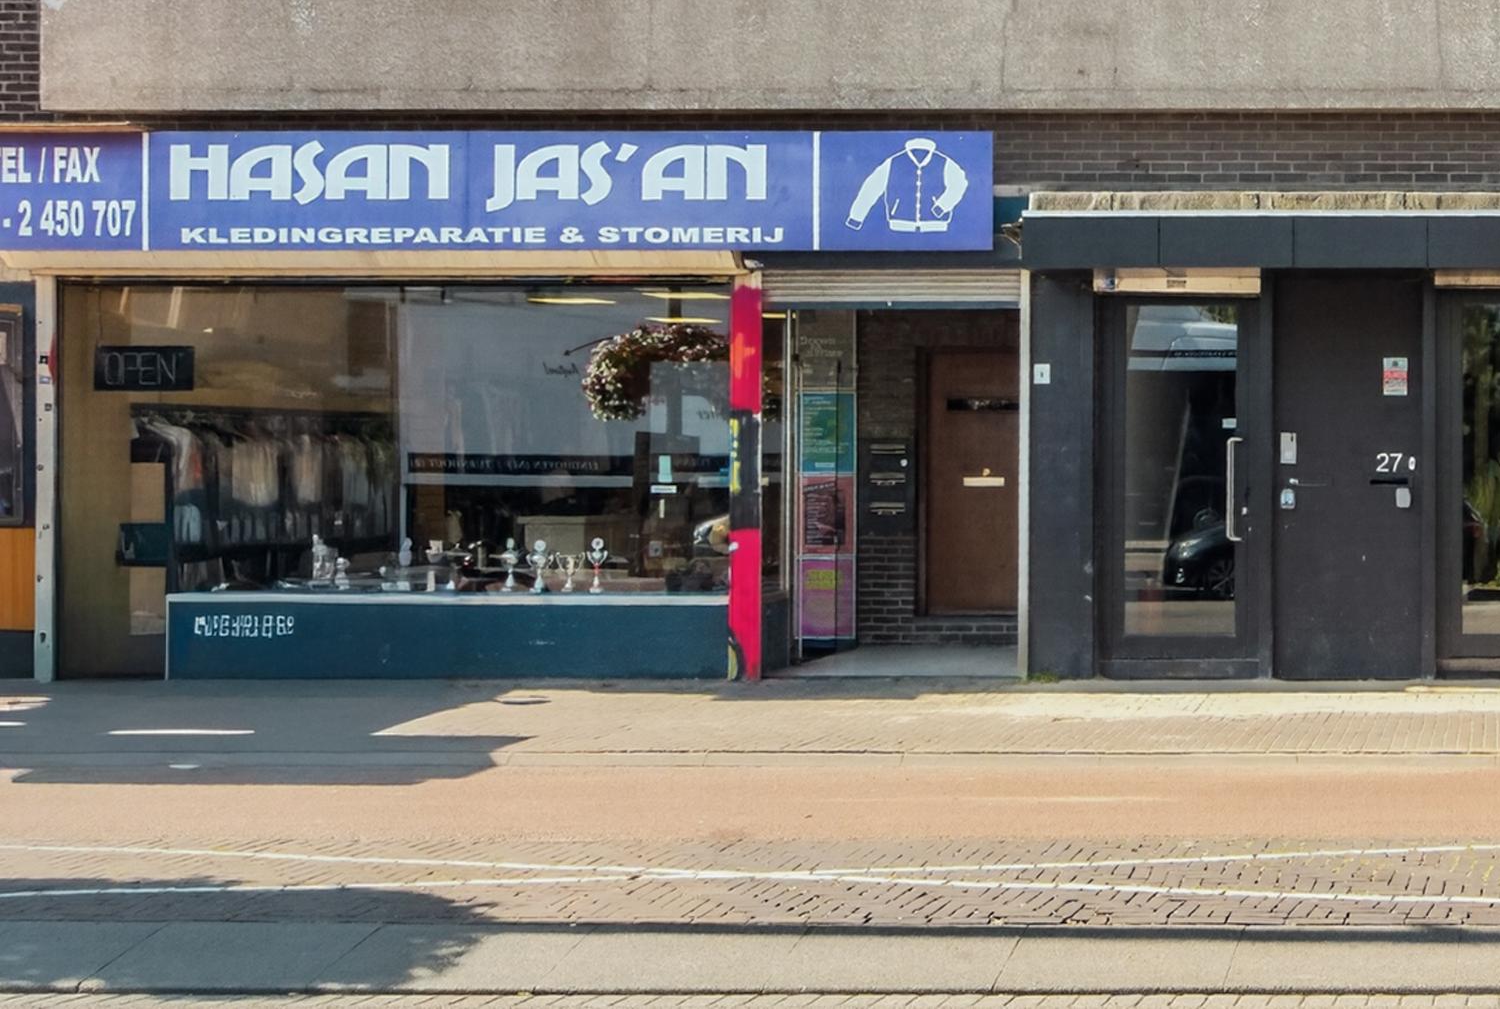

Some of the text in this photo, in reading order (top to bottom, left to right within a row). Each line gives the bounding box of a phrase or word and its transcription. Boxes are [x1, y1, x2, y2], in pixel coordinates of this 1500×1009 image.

[0, 146, 32, 183] EL
[53, 146, 101, 184] FAX
[169, 140, 450, 206] HASAN
[18, 199, 32, 237] 2
[40, 199, 84, 237] 450
[92, 199, 136, 237] 707
[181, 226, 785, 245] KLEDINGREPARATIE & STOMERIJ
[1375, 452, 1403, 473] 27
